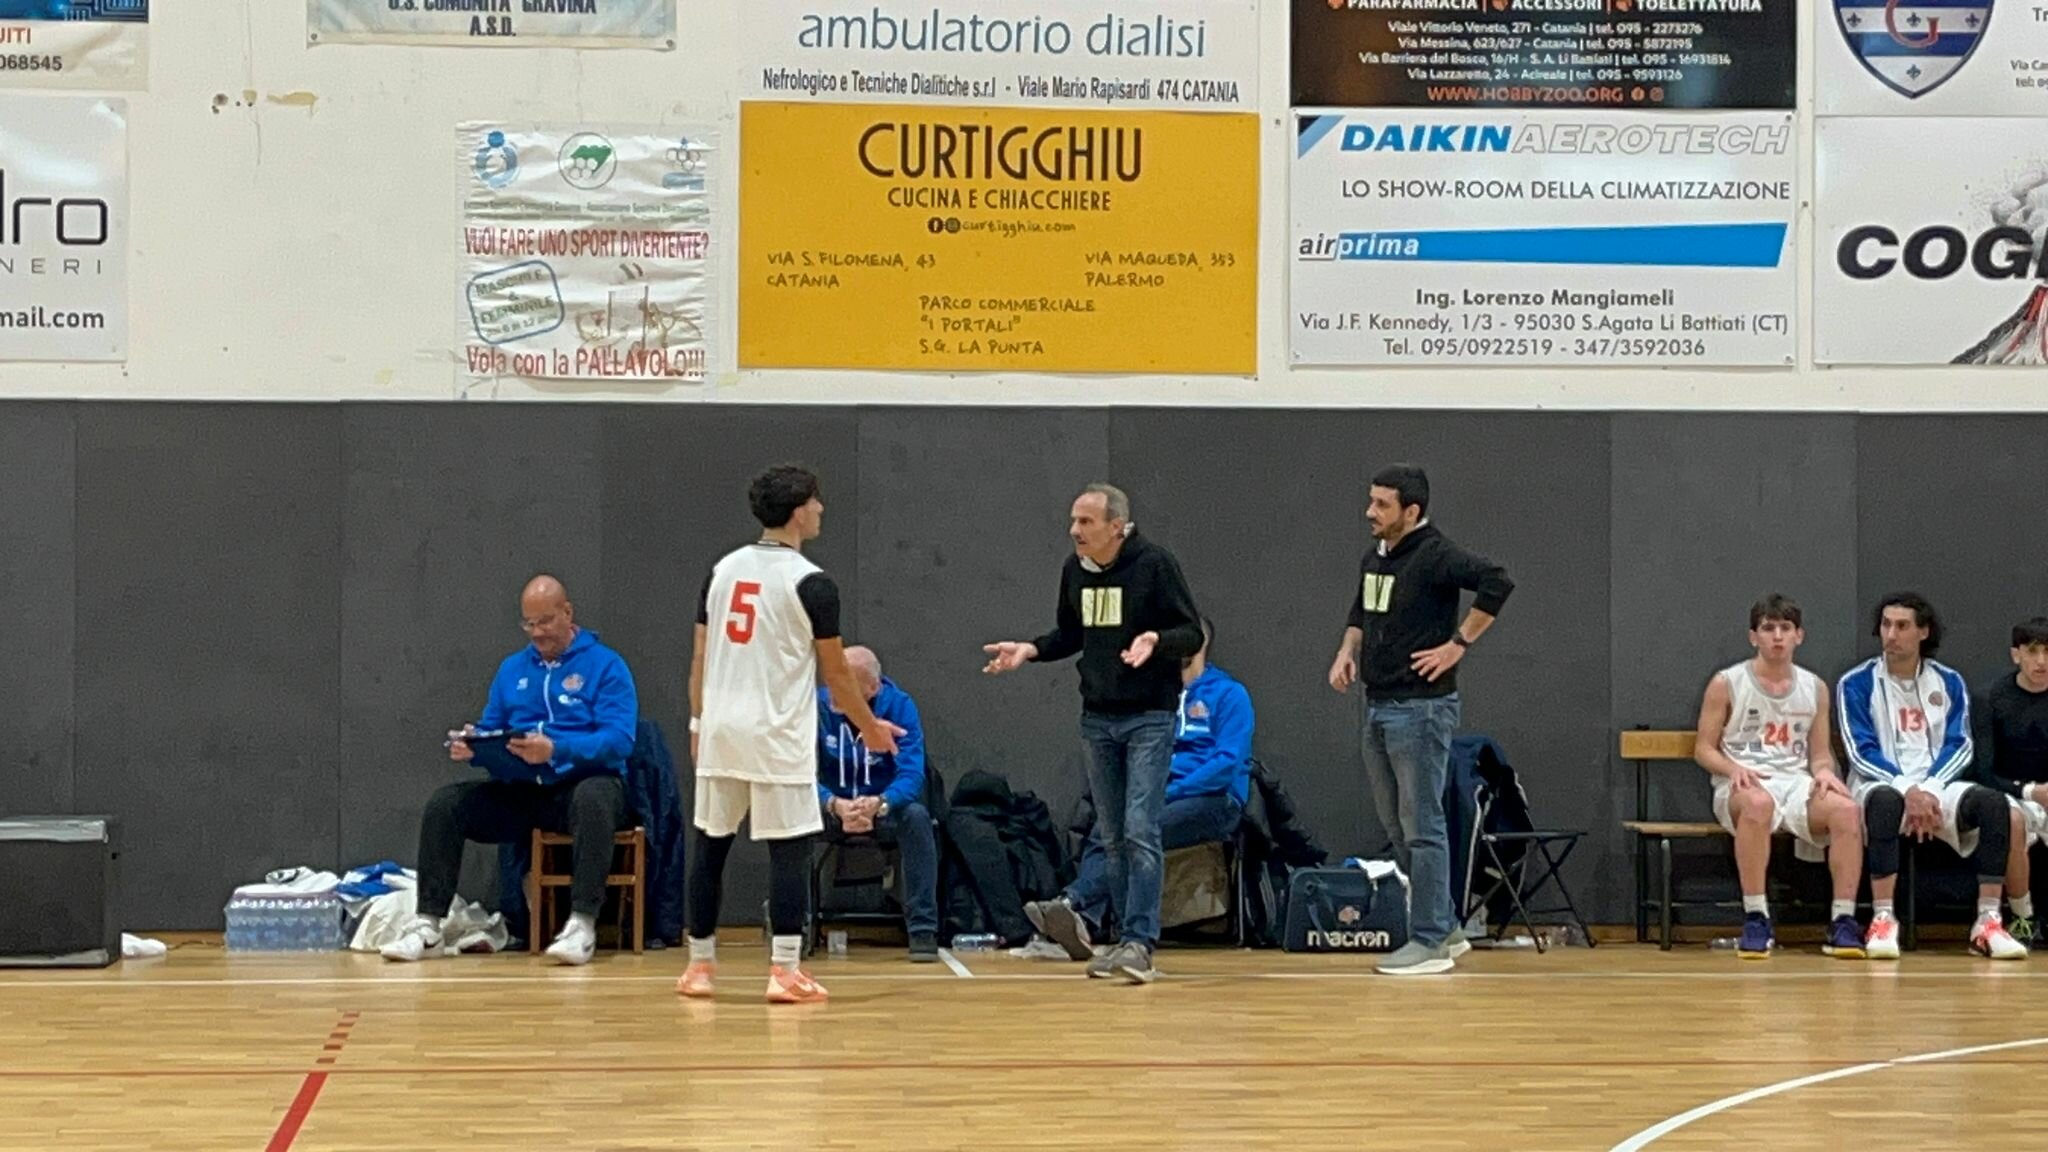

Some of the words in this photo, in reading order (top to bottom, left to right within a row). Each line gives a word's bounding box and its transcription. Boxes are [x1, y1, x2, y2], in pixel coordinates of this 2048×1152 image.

[1347, 0, 1478, 10] PARAFARMACIA
[1512, 0, 1600, 10] ACCESSORI
[1638, 0, 1763, 12] TOELETTATURA
[470, 16, 517, 37] A.S.D.
[798, 7, 1071, 55] ambulatorio
[1086, 13, 1206, 58] dialisi
[1387, 20, 1417, 34] Viale
[1465, 21, 1509, 36] Veneto,
[1511, 21, 1532, 33] 271
[1542, 21, 1586, 34] Catania
[1595, 22, 1615, 35] tel.
[1616, 22, 1641, 35] 095
[1398, 37, 1418, 48] Via
[1420, 37, 1471, 51] Messina,
[1473, 37, 1522, 50] 623/627
[1533, 37, 1577, 49] Catania
[1586, 38, 1605, 50] tel.
[1607, 38, 1632, 50] 095
[1643, 38, 1693, 50] 5872195
[1358, 52, 1379, 64] Via
[1429, 53, 1449, 64] del
[1491, 53, 1519, 66] 16/H
[1530, 54, 1541, 65] S.
[1543, 54, 1555, 65] A.
[1558, 53, 1568, 65] Li
[1622, 54, 1640, 65] tel.
[1642, 54, 1667, 65] 095
[1679, 54, 1731, 65] 16931814
[2010, 59, 2029, 71] Via
[1407, 68, 1427, 79] Via
[1495, 69, 1510, 79] 24
[1521, 69, 1567, 80] Acireale
[1576, 69, 1594, 80] tel.
[1597, 69, 1622, 80] 095
[1632, 69, 1683, 80] 9593126
[763, 67, 837, 96] Nefrologico
[840, 75, 848, 92] e
[851, 71, 908, 95] Tecniche
[911, 73, 969, 97] Dialitiche
[973, 77, 996, 98] s.r.l
[1018, 75, 1049, 98] Viale
[1052, 76, 1087, 98] Mario
[1091, 77, 1150, 103] Rapisardi
[1157, 79, 1179, 101] 474
[1182, 80, 1240, 103] CATANIA
[1427, 86, 1624, 102] WWW.HOBBYZOO.ORG
[1340, 124, 1513, 152] DAIKIN
[1511, 123, 1791, 156] AEROTECH
[858, 122, 1143, 184] CURTIGGHIU
[887, 187, 963, 210] CUCINA
[969, 188, 978, 209] E
[984, 189, 1113, 212] CHIACCHIERE
[1342, 179, 1371, 199] LO
[1378, 180, 1524, 199] SHOW-ROOM
[1532, 180, 1594, 200] DELLA
[1601, 181, 1791, 201] CLIMATIZZAZIONE
[0, 169, 108, 245] ro
[962, 220, 1077, 239] curtigghiu.com
[465, 227, 496, 255] VUOI
[500, 228, 537, 256] FARE
[539, 229, 568, 256] UNO
[571, 229, 618, 258] SPORT
[622, 230, 709, 259] DIVERTENTE?
[767, 251, 795, 266] VIA
[819, 252, 910, 272] FILOMENA,
[916, 254, 936, 268] 43
[1085, 251, 1112, 266] VIA
[1118, 251, 1204, 272] MAQUEDA,
[1210, 252, 1236, 268] 353
[767, 272, 841, 288] CATANIA
[1084, 271, 1166, 288] PALERMO
[919, 295, 972, 311] PARCO
[978, 297, 1096, 313] COMMERCIALE
[1416, 289, 1456, 310] Ing.
[1463, 289, 1546, 306] Lorenzo
[1551, 289, 1675, 310] Mangiameli
[1300, 313, 1330, 330] Via
[1336, 313, 1361, 331] J.F.
[1369, 313, 1453, 334] Kennedy,
[1462, 313, 1493, 332] 1/3
[1514, 314, 1575, 331] 95030
[1581, 314, 1653, 335] S.Agata
[1660, 313, 1674, 331] Li
[1681, 313, 1746, 331] Battiati
[1752, 313, 1789, 336] (CT)
[919, 338, 951, 354] S.G.
[959, 340, 982, 354] LA
[988, 339, 1044, 355] PUNTA
[1383, 338, 1414, 355] Tel.
[1421, 338, 1553, 357] 095/0922519
[1573, 338, 1706, 357] 347/3592036
[465, 344, 507, 375] Vola
[512, 353, 547, 376] con
[553, 348, 570, 376] la
[575, 348, 706, 378] PALLAVOLO!!!
[725, 581, 762, 645] 5
[1899, 707, 1924, 733] 13
[1764, 720, 1790, 748] 24
[1307, 930, 1391, 948] macron
